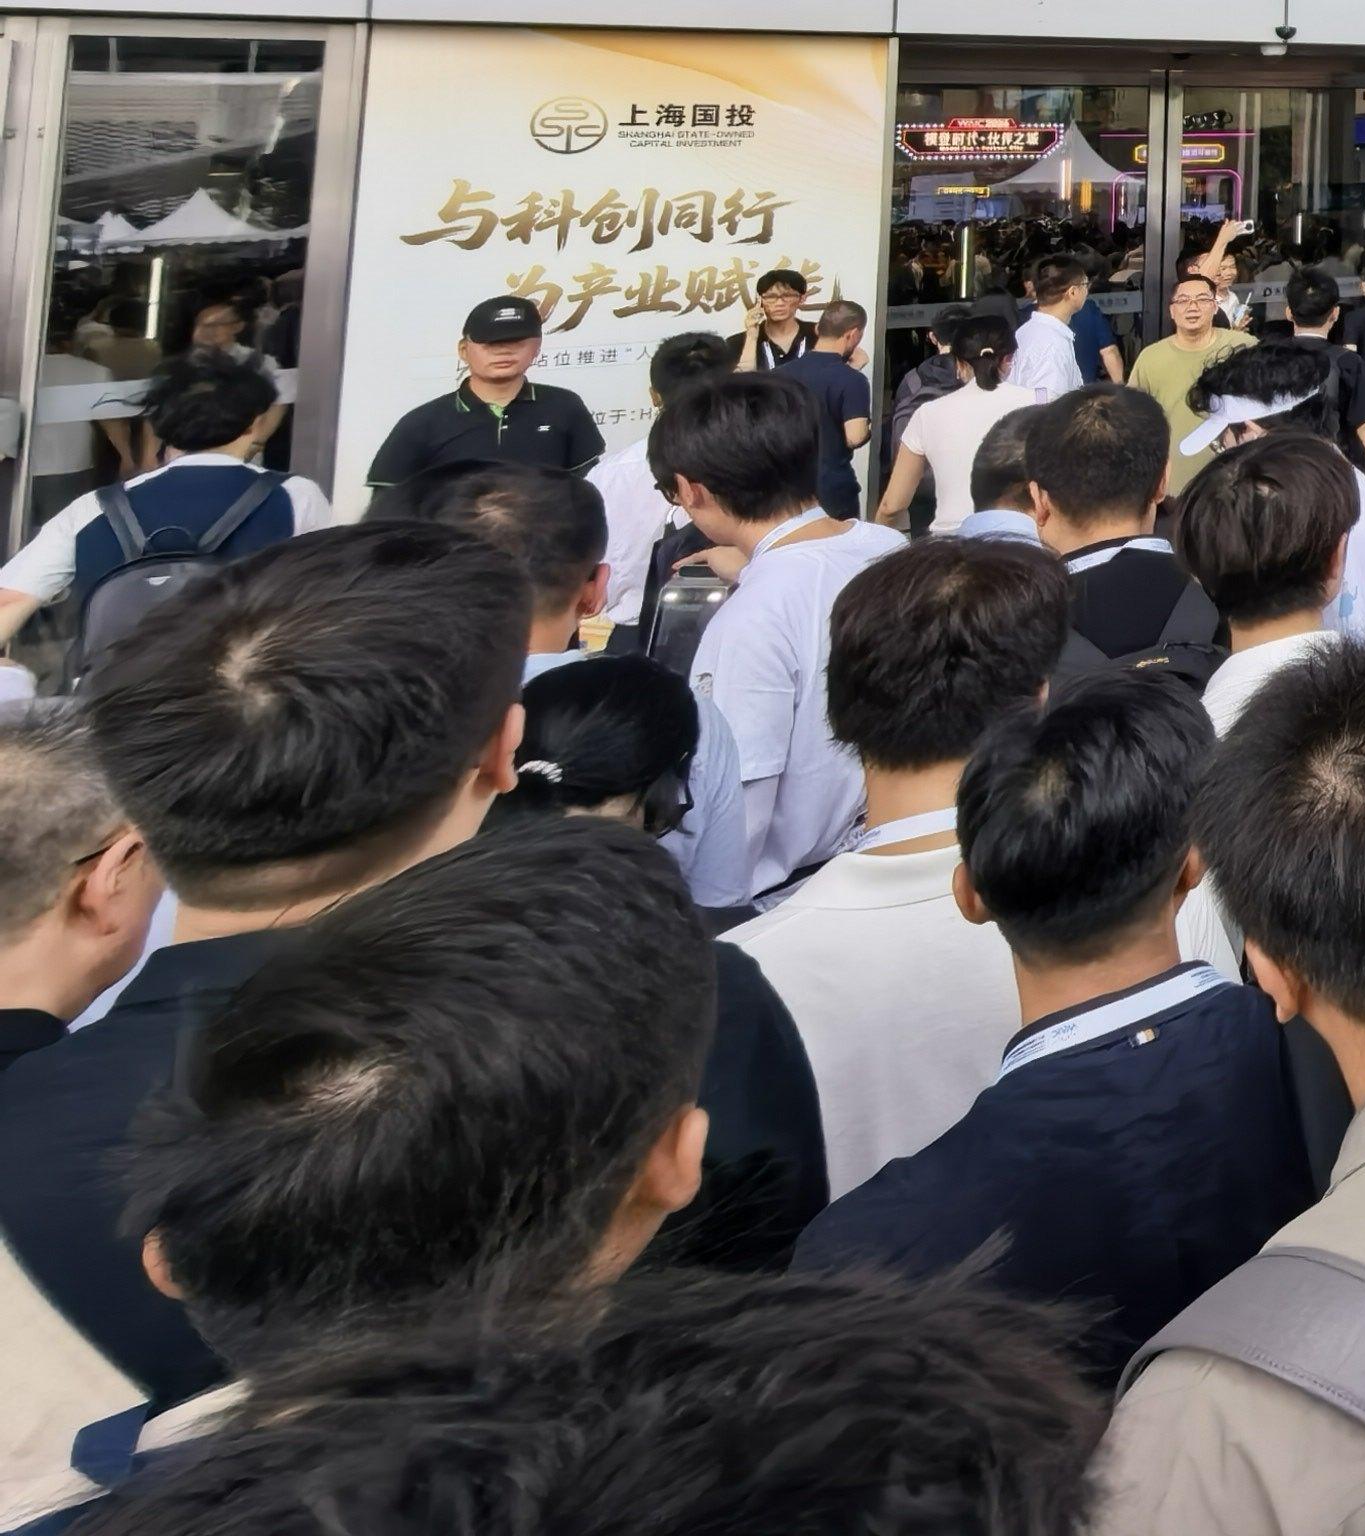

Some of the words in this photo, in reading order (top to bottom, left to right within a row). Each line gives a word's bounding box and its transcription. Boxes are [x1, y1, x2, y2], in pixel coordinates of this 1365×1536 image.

[618, 104, 756, 127] 上海国投
[629, 140, 673, 148] CAPITAL
[399, 178, 798, 254] 与科创同行
